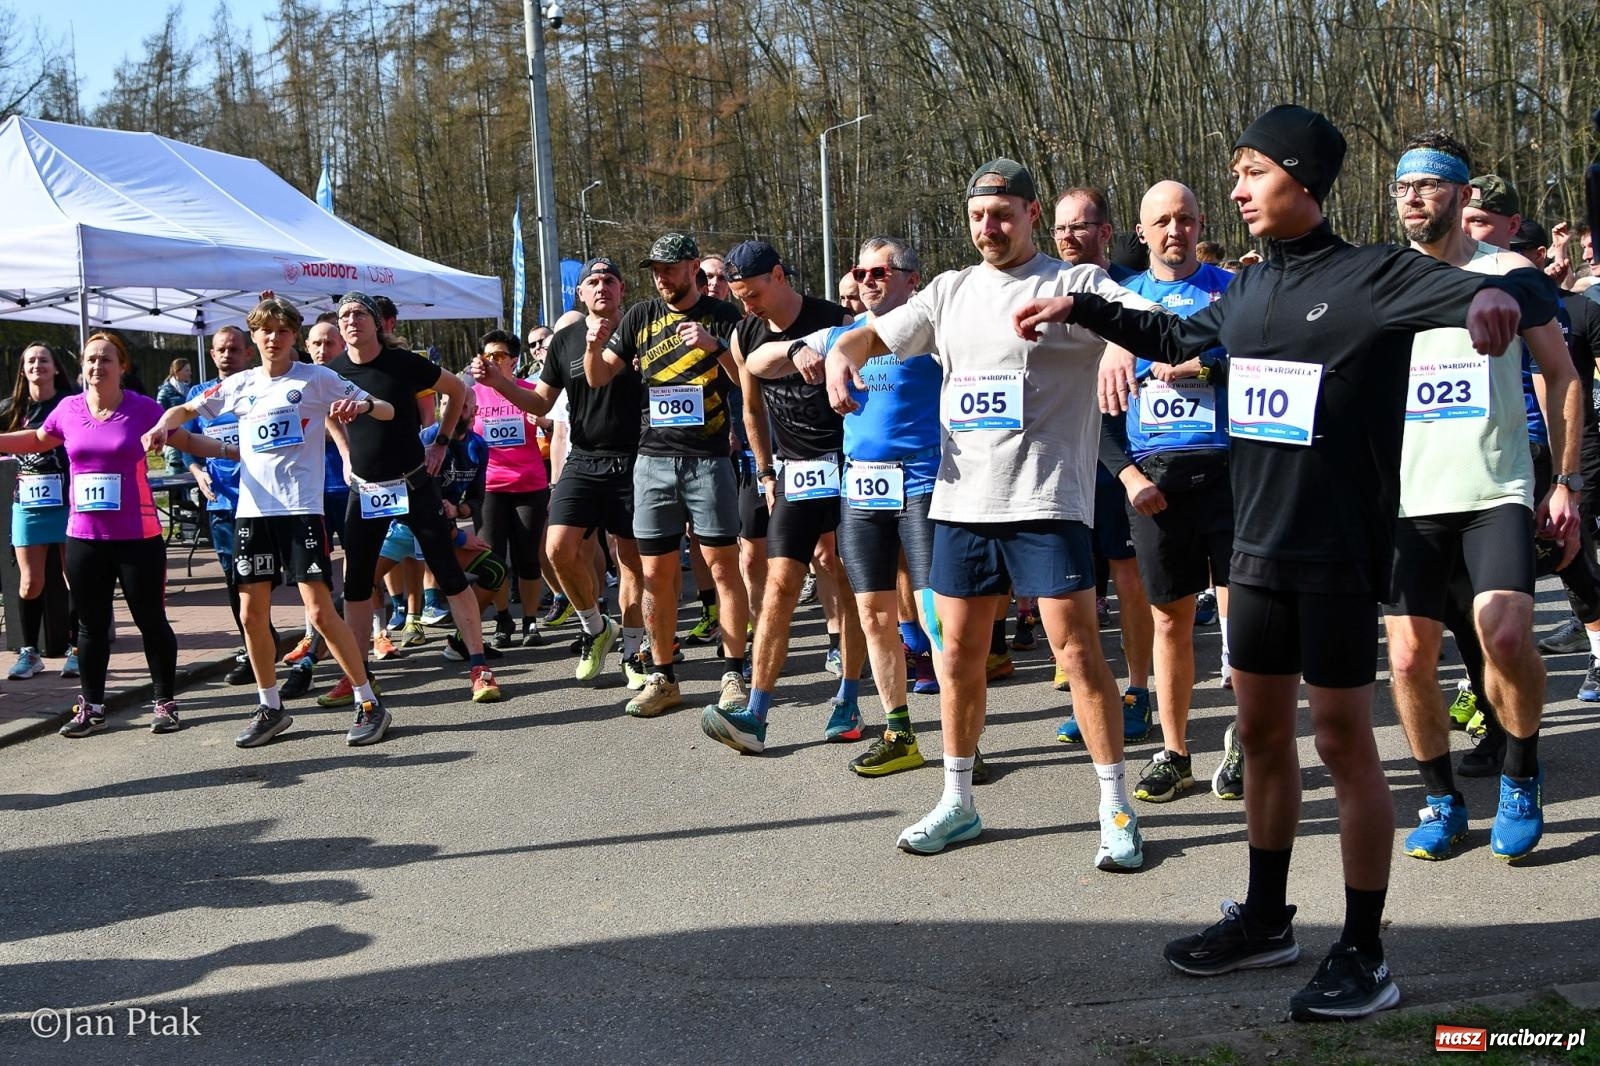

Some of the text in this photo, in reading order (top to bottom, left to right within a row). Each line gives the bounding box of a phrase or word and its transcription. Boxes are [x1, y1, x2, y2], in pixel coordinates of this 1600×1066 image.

[646, 335, 684, 362] UNMAGE
[1417, 379, 1472, 405] 023
[658, 399, 694, 415] 080
[960, 391, 1007, 415] 055
[1153, 397, 1200, 418] 067
[1245, 387, 1289, 418] 110
[258, 420, 290, 440] 037
[490, 426, 518, 439] 002
[214, 434, 240, 446] 59
[793, 469, 826, 489] 051
[855, 477, 890, 496] 130
[29, 485, 51, 498] 112
[85, 486, 105, 501] 111
[370, 492, 398, 508] 021
